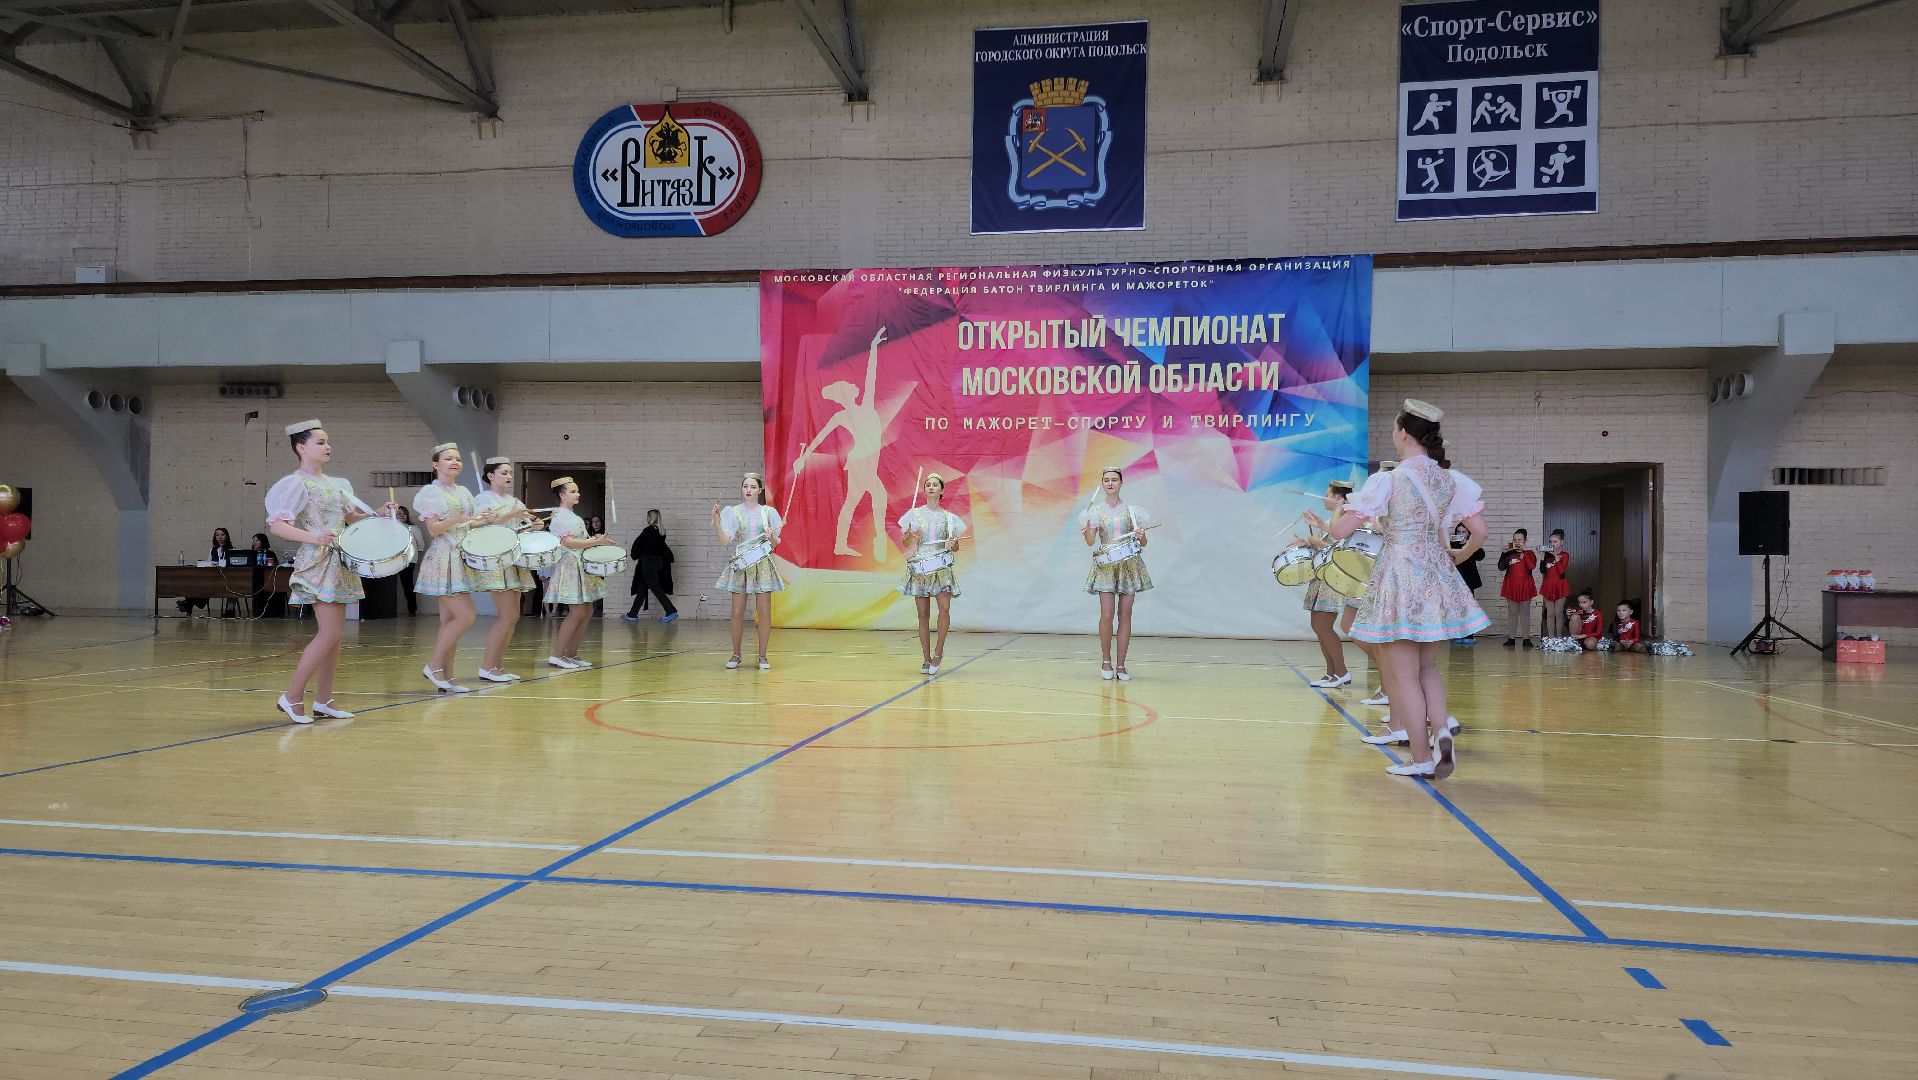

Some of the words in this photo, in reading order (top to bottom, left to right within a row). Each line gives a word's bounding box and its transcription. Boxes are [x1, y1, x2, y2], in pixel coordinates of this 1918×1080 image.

[1401, 10, 1598, 40] «Спорт-Сервис»
[1012, 30, 1109, 46] АДМИНИСТРАЦИЯ
[975, 48, 1042, 64] ГОРОДСКОГО
[1045, 46, 1086, 59] ОКРУГА
[1088, 43, 1147, 58] ПОДОЛЬСК
[1446, 42, 1548, 64] Подольск
[774, 273, 855, 283] МОСКОВСКАЯ
[861, 272, 933, 282] ОБЛАСТНАЯ
[938, 270, 1037, 280] РЕГИОНАЛЬНАЯ
[1043, 264, 1242, 278] ФИЗКУЛЬТУРНО-СПОРТИВНАЯ
[1249, 260, 1351, 271] ОРГАНИЗАЦИЯ
[983, 285, 1024, 295] БАТОН
[1029, 282, 1106, 293] ТВИРЛИНГА
[1111, 282, 1120, 291] И
[957, 314, 1106, 350] ОТКРЫТЫЙ
[1114, 313, 1285, 347] ЧЕМПИОНАТ
[962, 360, 1141, 396] МОСКОВСКОЙ
[1149, 361, 1280, 394] ОБЛАСТИ
[925, 416, 949, 430] ПО
[963, 415, 1146, 430] МАЖОРЕТ-СПОРТУ
[1162, 415, 1174, 429] И
[1190, 413, 1317, 429] ТВИРЛИНГУ
